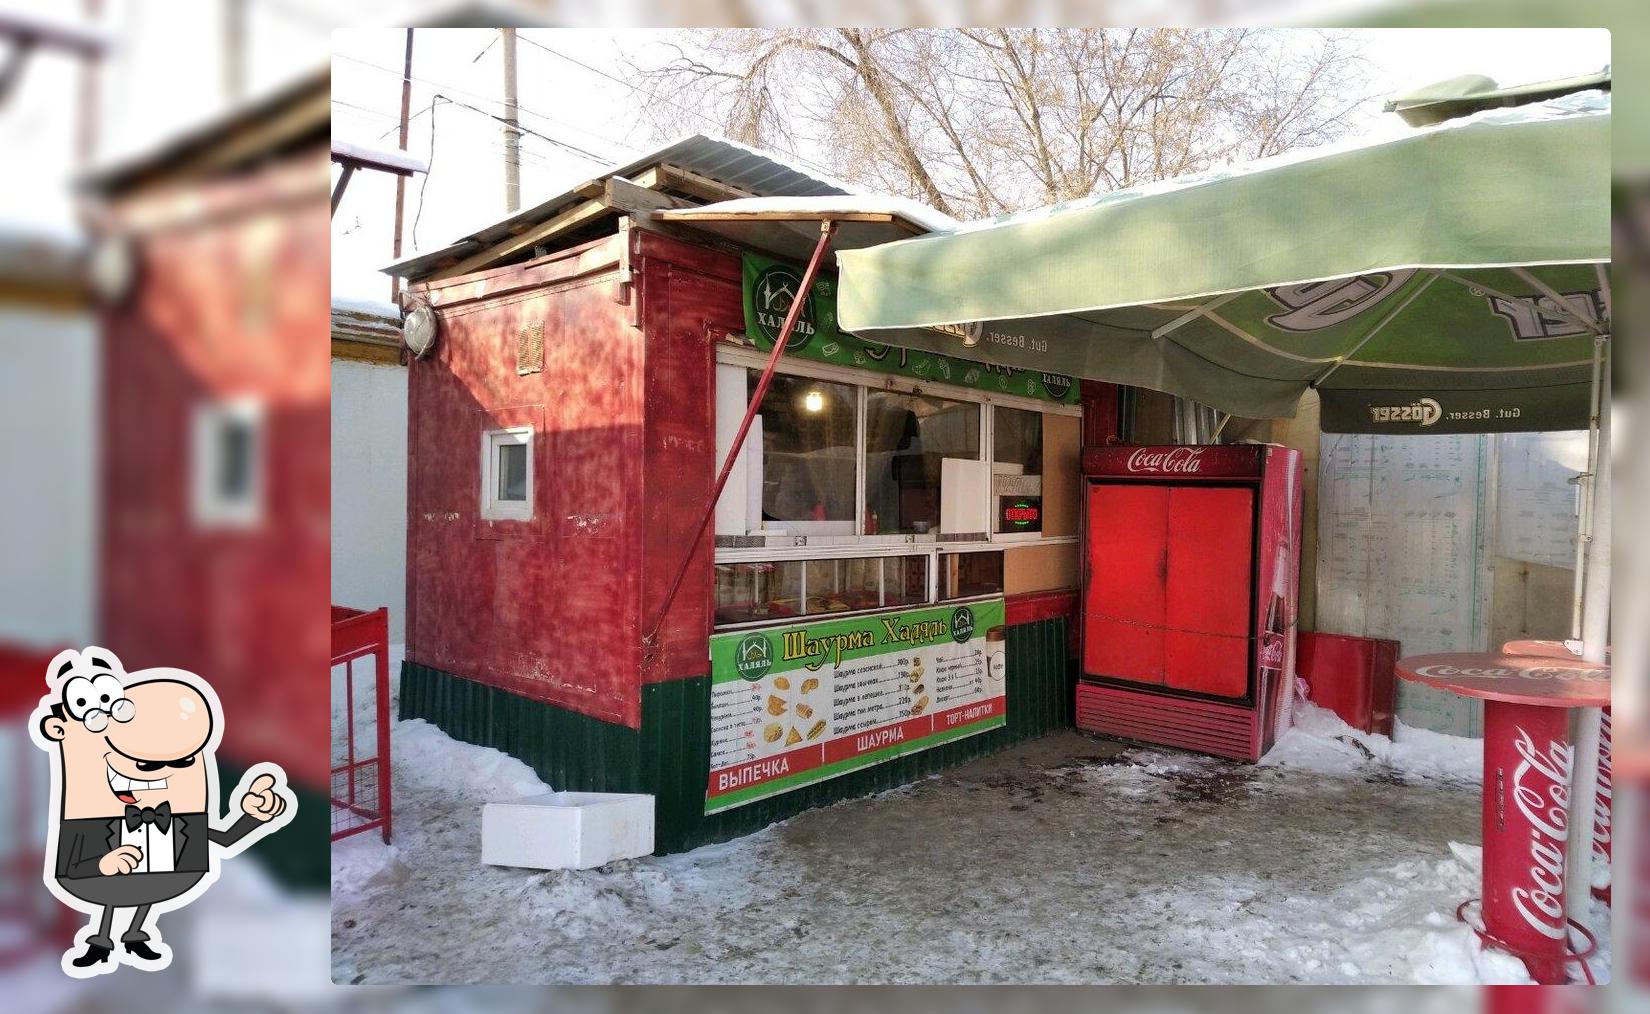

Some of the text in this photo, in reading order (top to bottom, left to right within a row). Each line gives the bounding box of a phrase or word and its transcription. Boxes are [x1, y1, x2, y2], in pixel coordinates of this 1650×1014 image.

[757, 311, 816, 335] ХАЛЛЬ
[1127, 447, 1206, 473] Coca-Cola
[783, 617, 948, 672] Шаурма Халяль
[738, 659, 773, 671] ХАЛЯЛЬ
[946, 704, 993, 725] ТОРТ-НАПИТКИ
[857, 726, 904, 751] ШАУРМА
[718, 756, 790, 791] ВЫПЕЧКА
